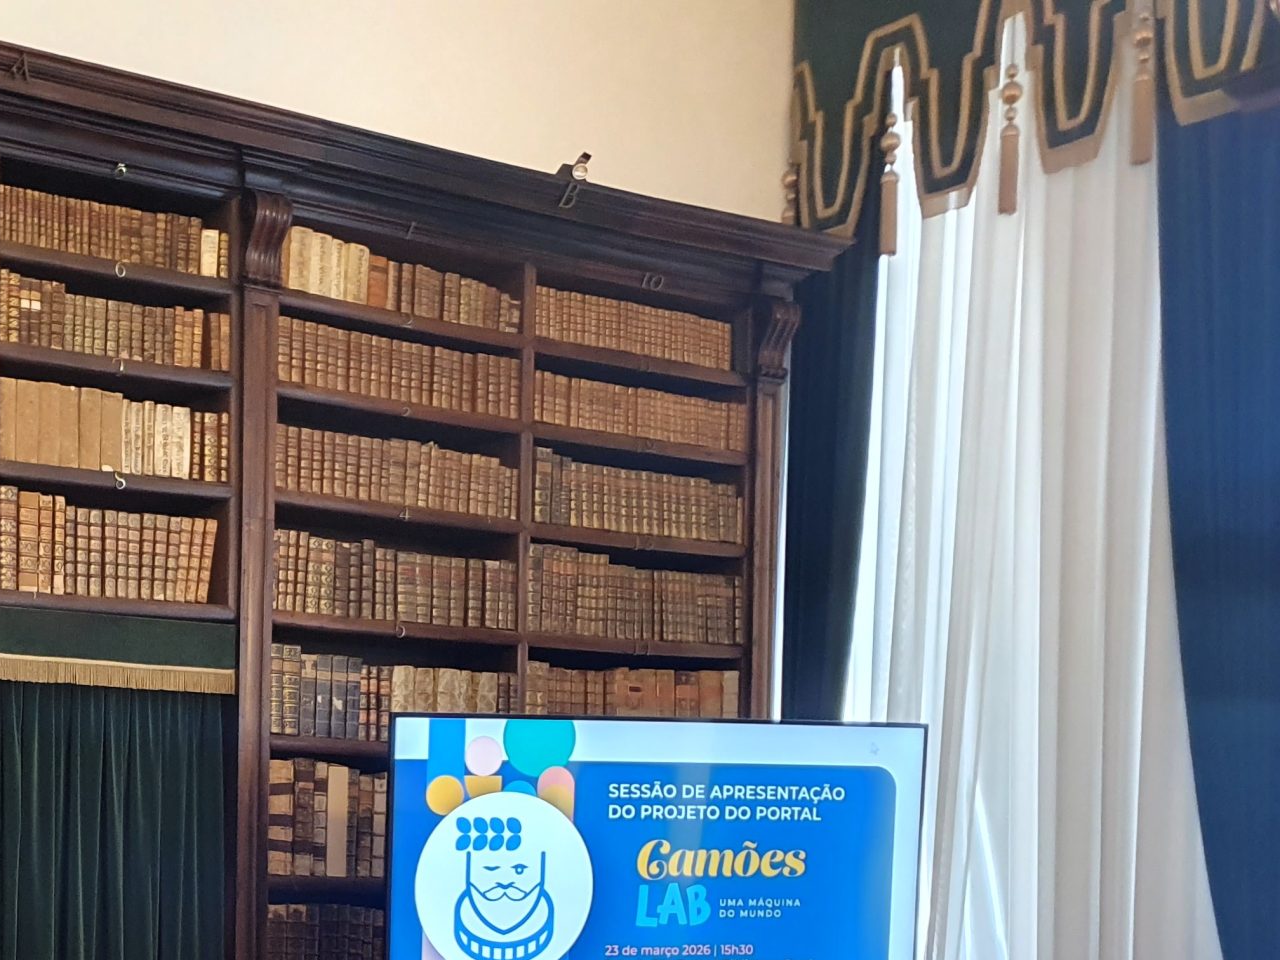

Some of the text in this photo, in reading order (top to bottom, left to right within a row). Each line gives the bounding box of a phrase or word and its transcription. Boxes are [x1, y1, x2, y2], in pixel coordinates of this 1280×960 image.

[10, 53, 30, 81] A
[559, 182, 580, 208] B
[641, 272, 664, 291] 10
[399, 506, 412, 522] 4
[608, 781, 846, 804] SESSÃO DE APRESENTAÇÃO
[608, 804, 822, 821] DO PROJETO DO PORTAL
[637, 838, 807, 880] Camões
[635, 882, 711, 927] LAB
[719, 896, 801, 907] UMA MÁQUINA
[719, 909, 782, 918] DO MUNDO
[604, 945, 619, 956] 23
[622, 945, 637, 956] de
[640, 946, 679, 958] março
[682, 945, 711, 956] 2026
[720, 944, 754, 955] 15h30
